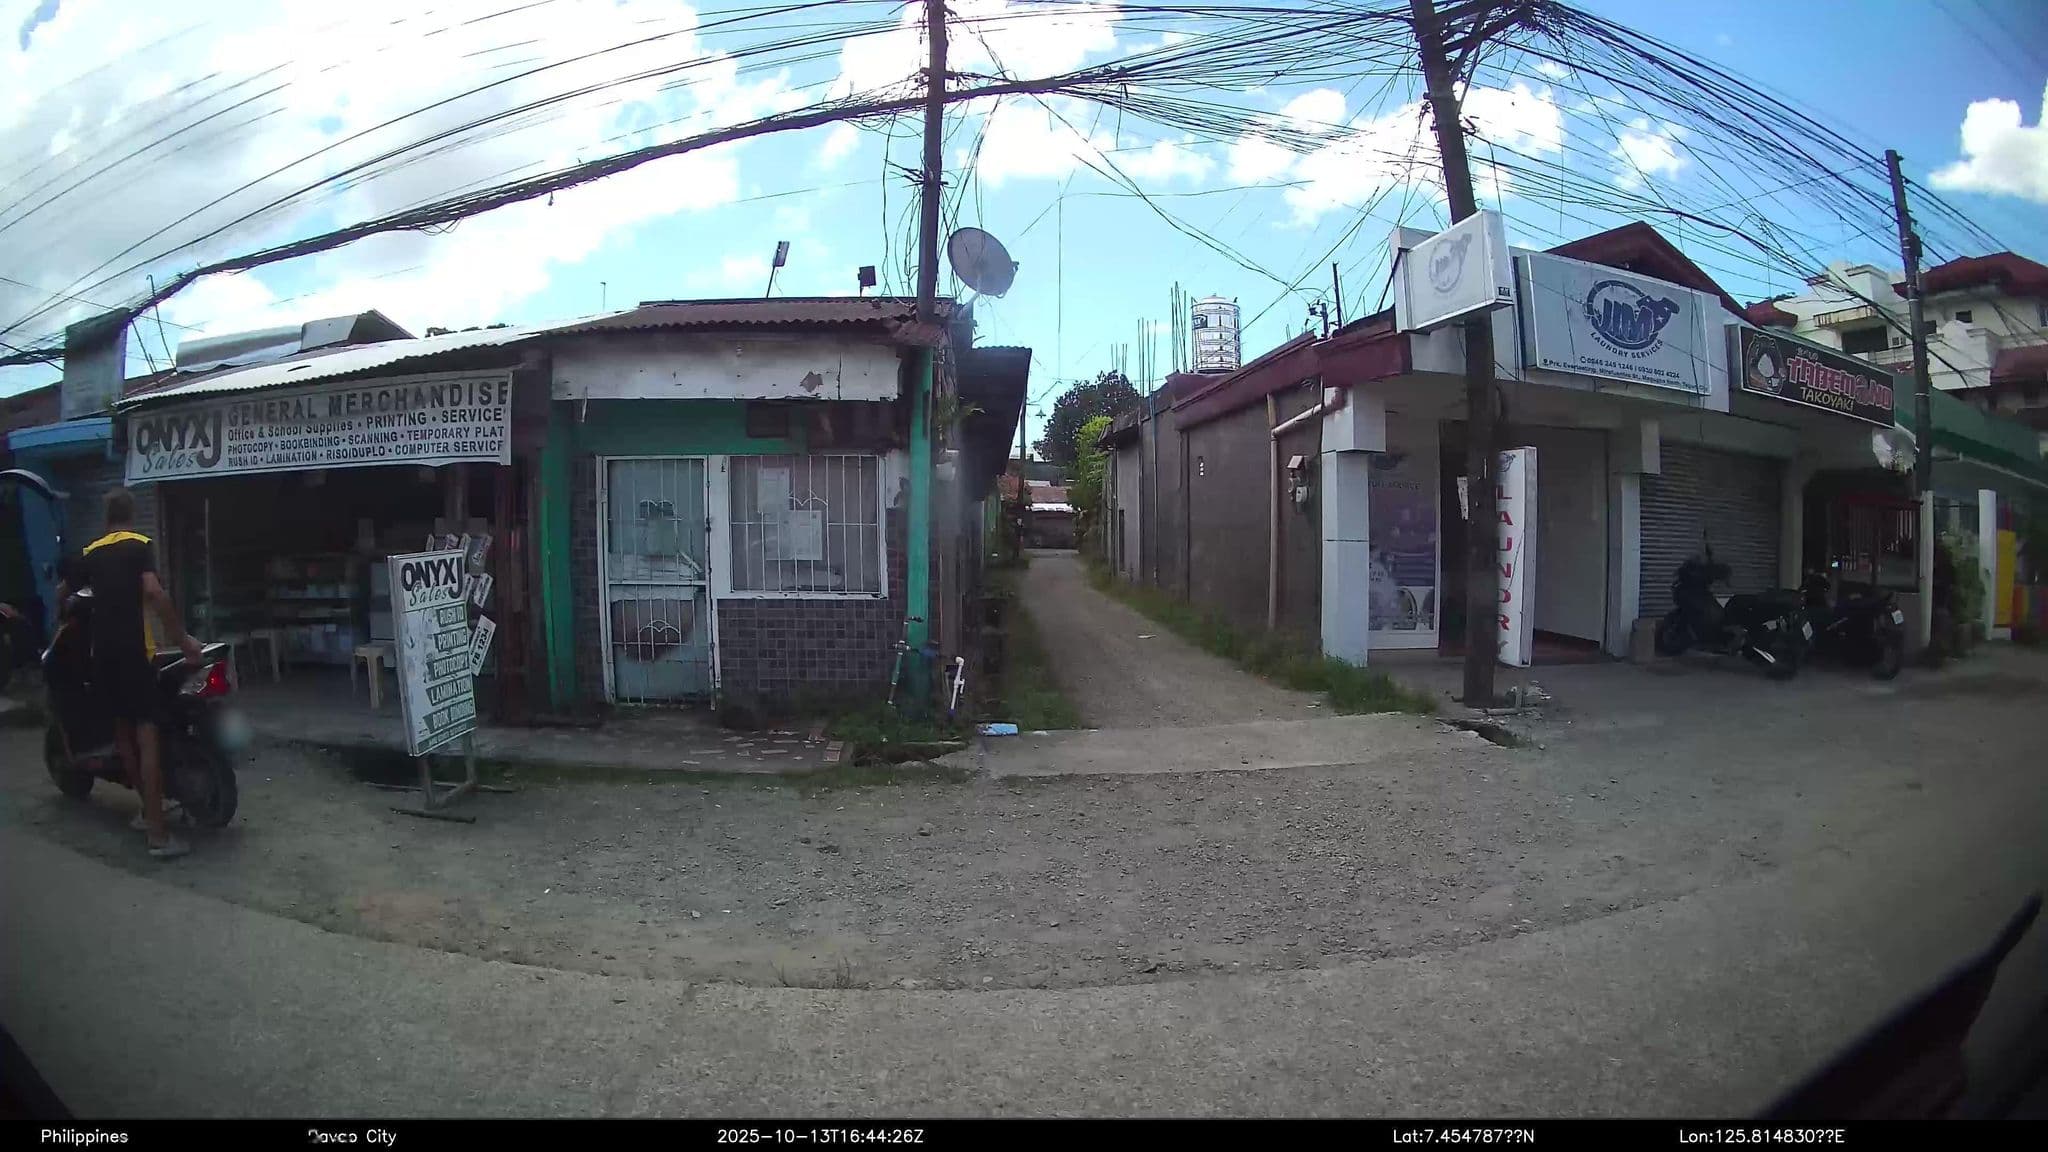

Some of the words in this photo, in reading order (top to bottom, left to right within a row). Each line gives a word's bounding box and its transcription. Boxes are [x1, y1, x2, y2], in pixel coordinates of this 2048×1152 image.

[1590, 331, 1628, 358] LAUNDRY
[1631, 339, 1663, 359] SERVICES
[227, 398, 318, 427] GENERAL
[328, 381, 508, 417] MERCHANDISE
[1800, 386, 1855, 412] TAKOYAKI
[228, 427, 255, 442] Office
[258, 426, 265, 439] &
[268, 424, 302, 437] School
[305, 420, 353, 436] Supplies
[366, 411, 427, 430] PRINTING
[441, 408, 507, 424] SERVICE
[228, 441, 273, 455] PHOTOCOPY
[280, 436, 340, 450] BOOKBINDING
[349, 431, 398, 445] SCANNING
[407, 427, 470, 441] TEMPORARY
[228, 454, 249, 467] RUSH
[250, 454, 258, 465] ID
[265, 450, 317, 465] LAMINATION
[395, 442, 450, 456] COMPUTER
[142, 442, 194, 474] Sales
[401, 557, 463, 600] ONYXJ
[409, 581, 448, 607] Sales
[438, 628, 467, 650] PRINTING
[433, 652, 469, 679] PHOTOCOPY
[430, 677, 472, 704] LAMINATION
[432, 708, 450, 730] BOOK
